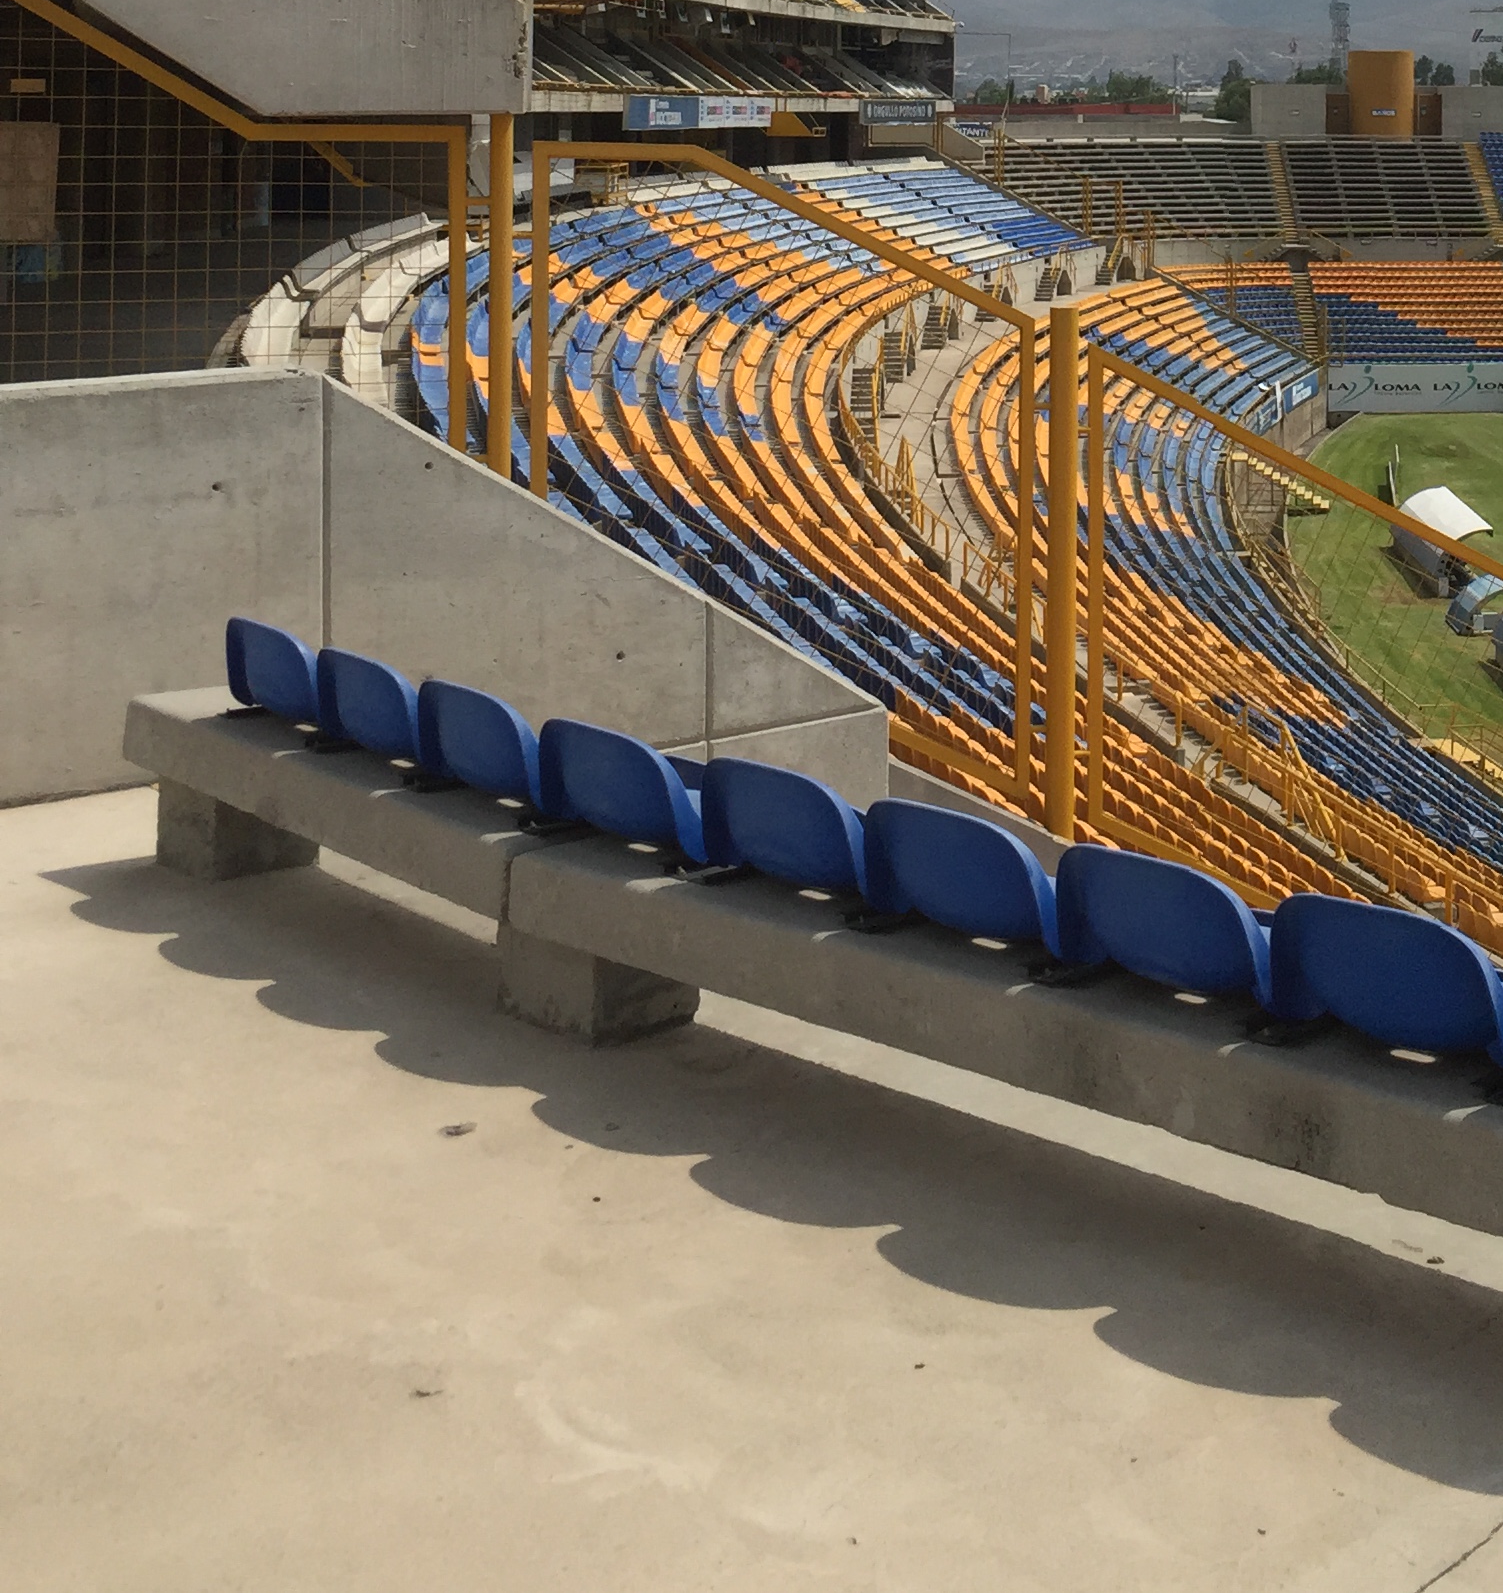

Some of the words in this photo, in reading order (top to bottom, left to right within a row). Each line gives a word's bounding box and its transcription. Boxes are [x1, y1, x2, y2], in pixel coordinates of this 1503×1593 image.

[1329, 382, 1349, 392] LA
[1374, 382, 1422, 392] LOMA
[1434, 382, 1452, 391] LA
